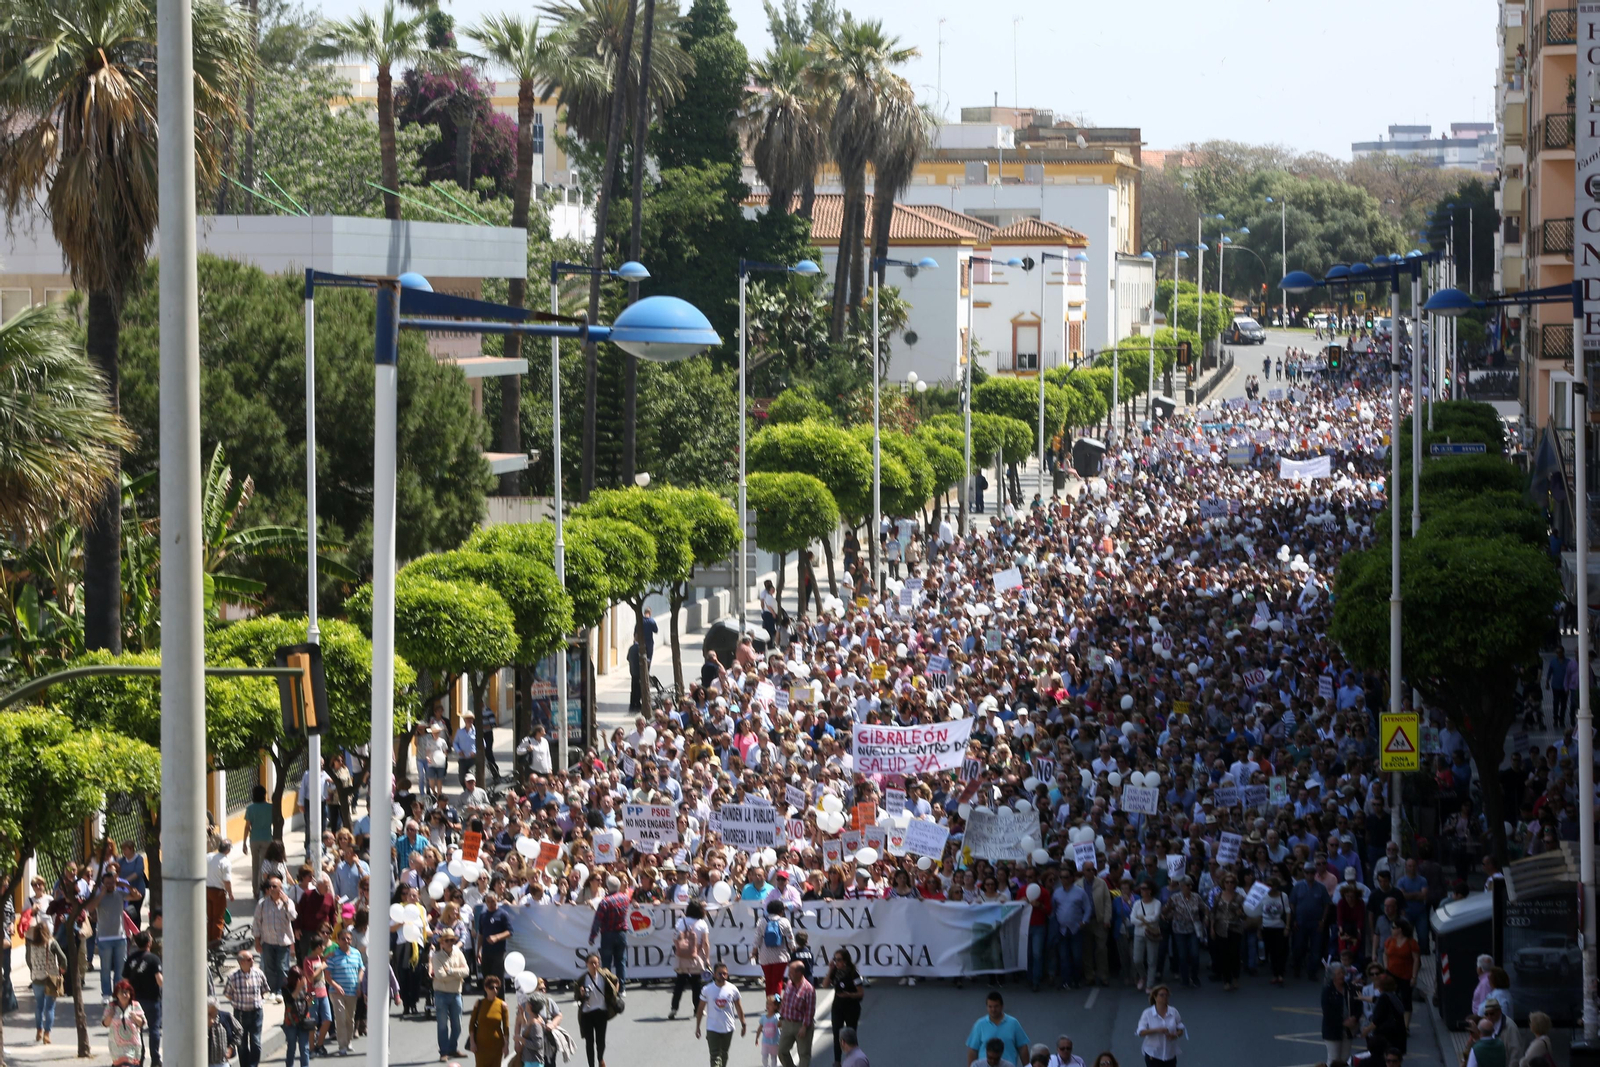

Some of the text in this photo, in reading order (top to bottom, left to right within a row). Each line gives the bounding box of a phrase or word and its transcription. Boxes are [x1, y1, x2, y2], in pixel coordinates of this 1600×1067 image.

[932, 673, 947, 689] NO
[1243, 669, 1266, 687] NO
[858, 745, 896, 757] NUEVO
[899, 742, 951, 755] CENTRO
[858, 756, 907, 773] SALUD
[961, 760, 979, 780] NO
[1036, 760, 1052, 782] NO
[627, 806, 671, 818] PP PSOE
[744, 806, 751, 823] LA
[625, 818, 675, 830] NO NOS ENGAÑEIS
[786, 820, 803, 839] NO
[748, 830, 754, 844] LA
[755, 830, 774, 845] PRIVADA
[815, 907, 876, 930] UNA
